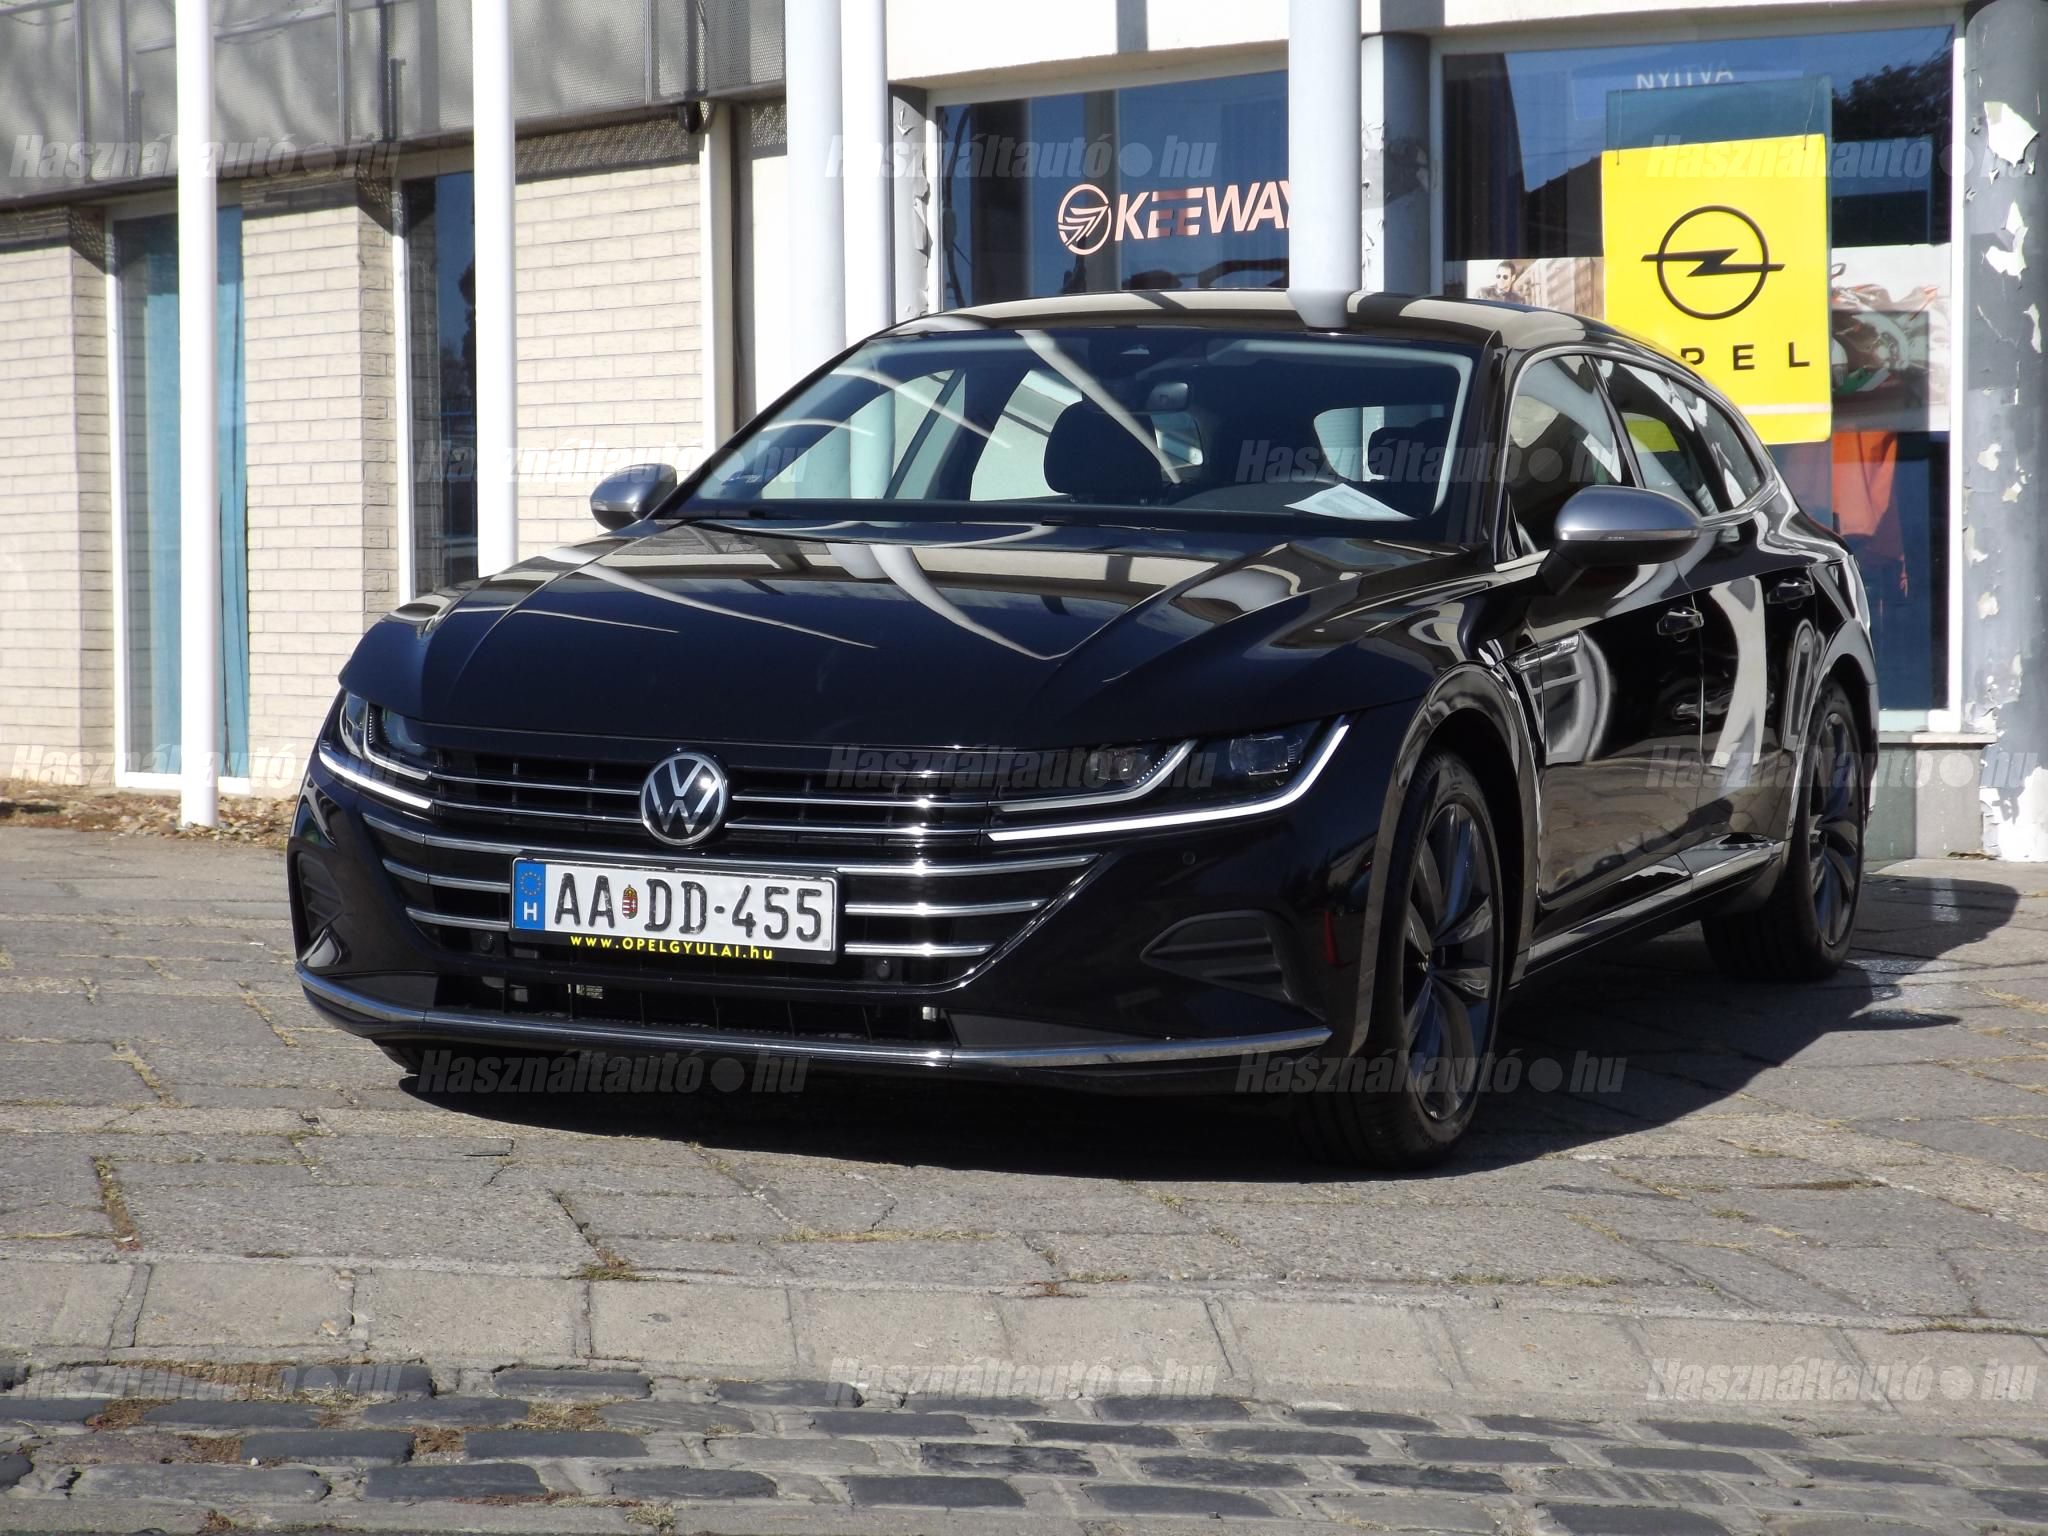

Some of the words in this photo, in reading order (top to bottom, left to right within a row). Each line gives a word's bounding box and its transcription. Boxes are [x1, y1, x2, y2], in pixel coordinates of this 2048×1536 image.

[1635, 61, 1735, 89] NYITVA
[1680, 341, 1811, 371] PEL
[523, 901, 538, 921] H
[570, 934, 774, 960] www.OPELGYULAI.hu
